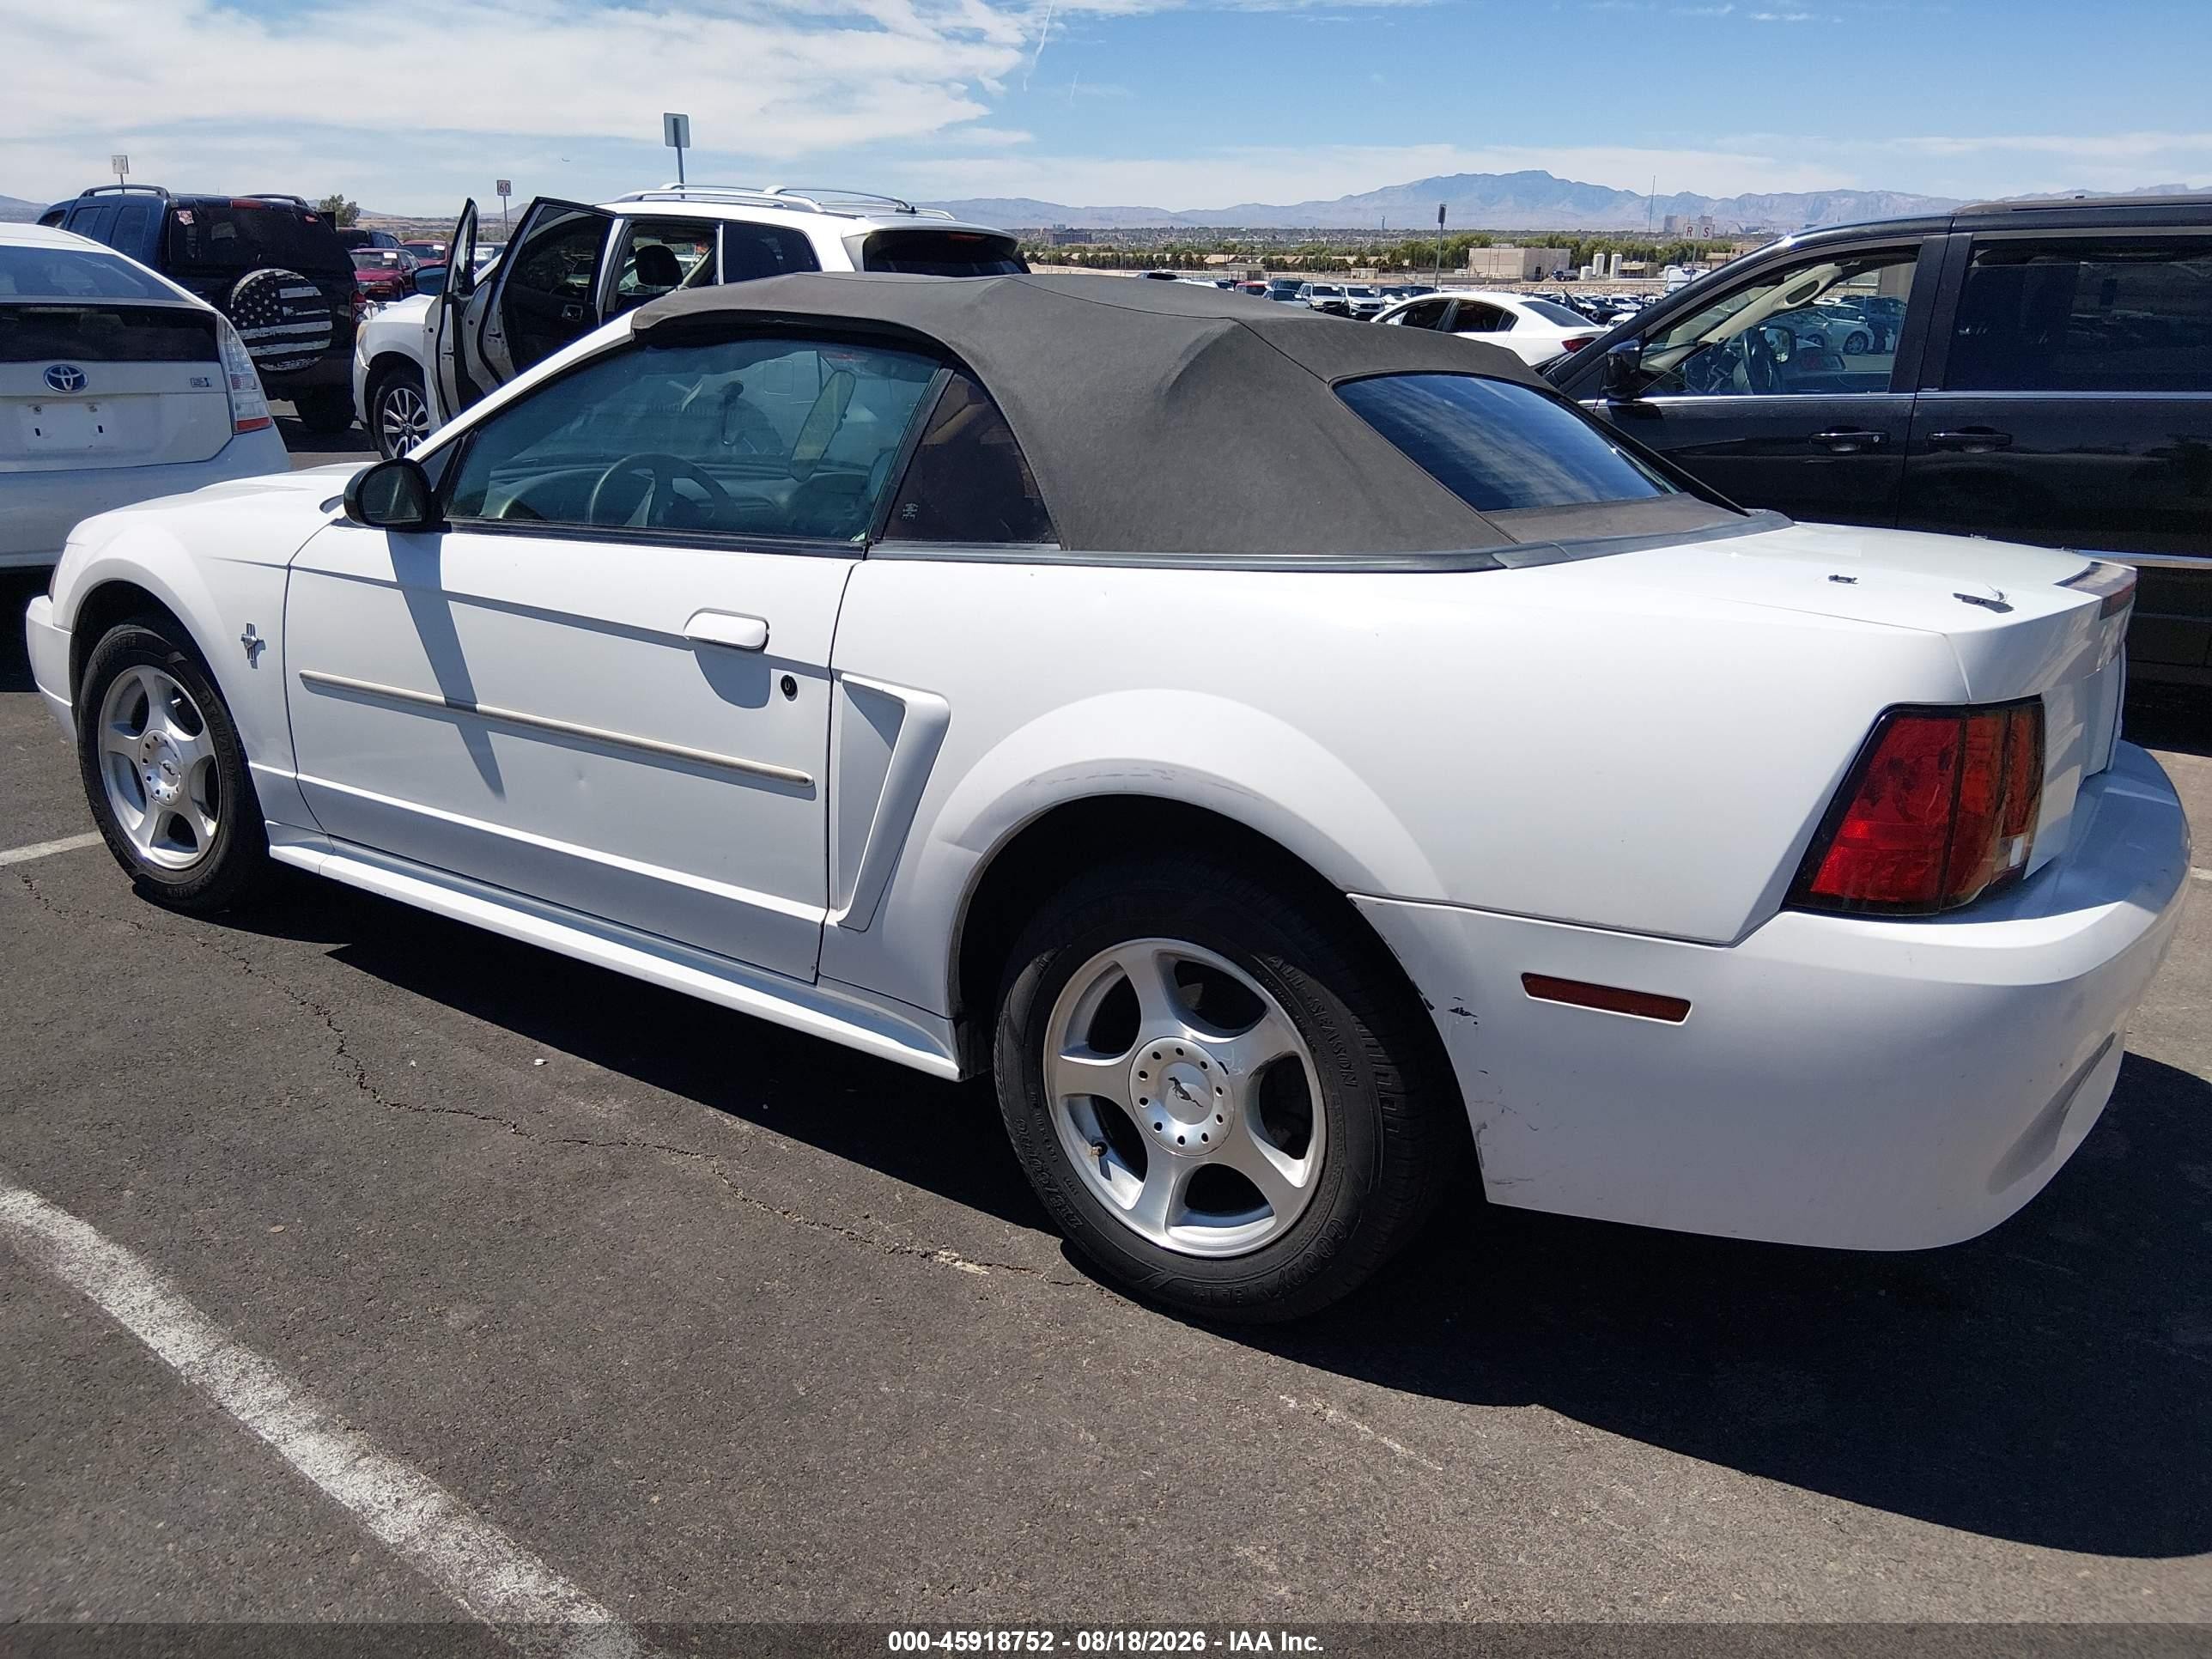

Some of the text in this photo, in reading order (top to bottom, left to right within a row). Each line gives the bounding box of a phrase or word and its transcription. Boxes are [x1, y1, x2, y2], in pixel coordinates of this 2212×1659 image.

[499, 183, 510, 193] 60
[1686, 226, 1693, 237] R
[1703, 227, 1710, 238] S
[1308, 998, 1359, 1088] SEASON
